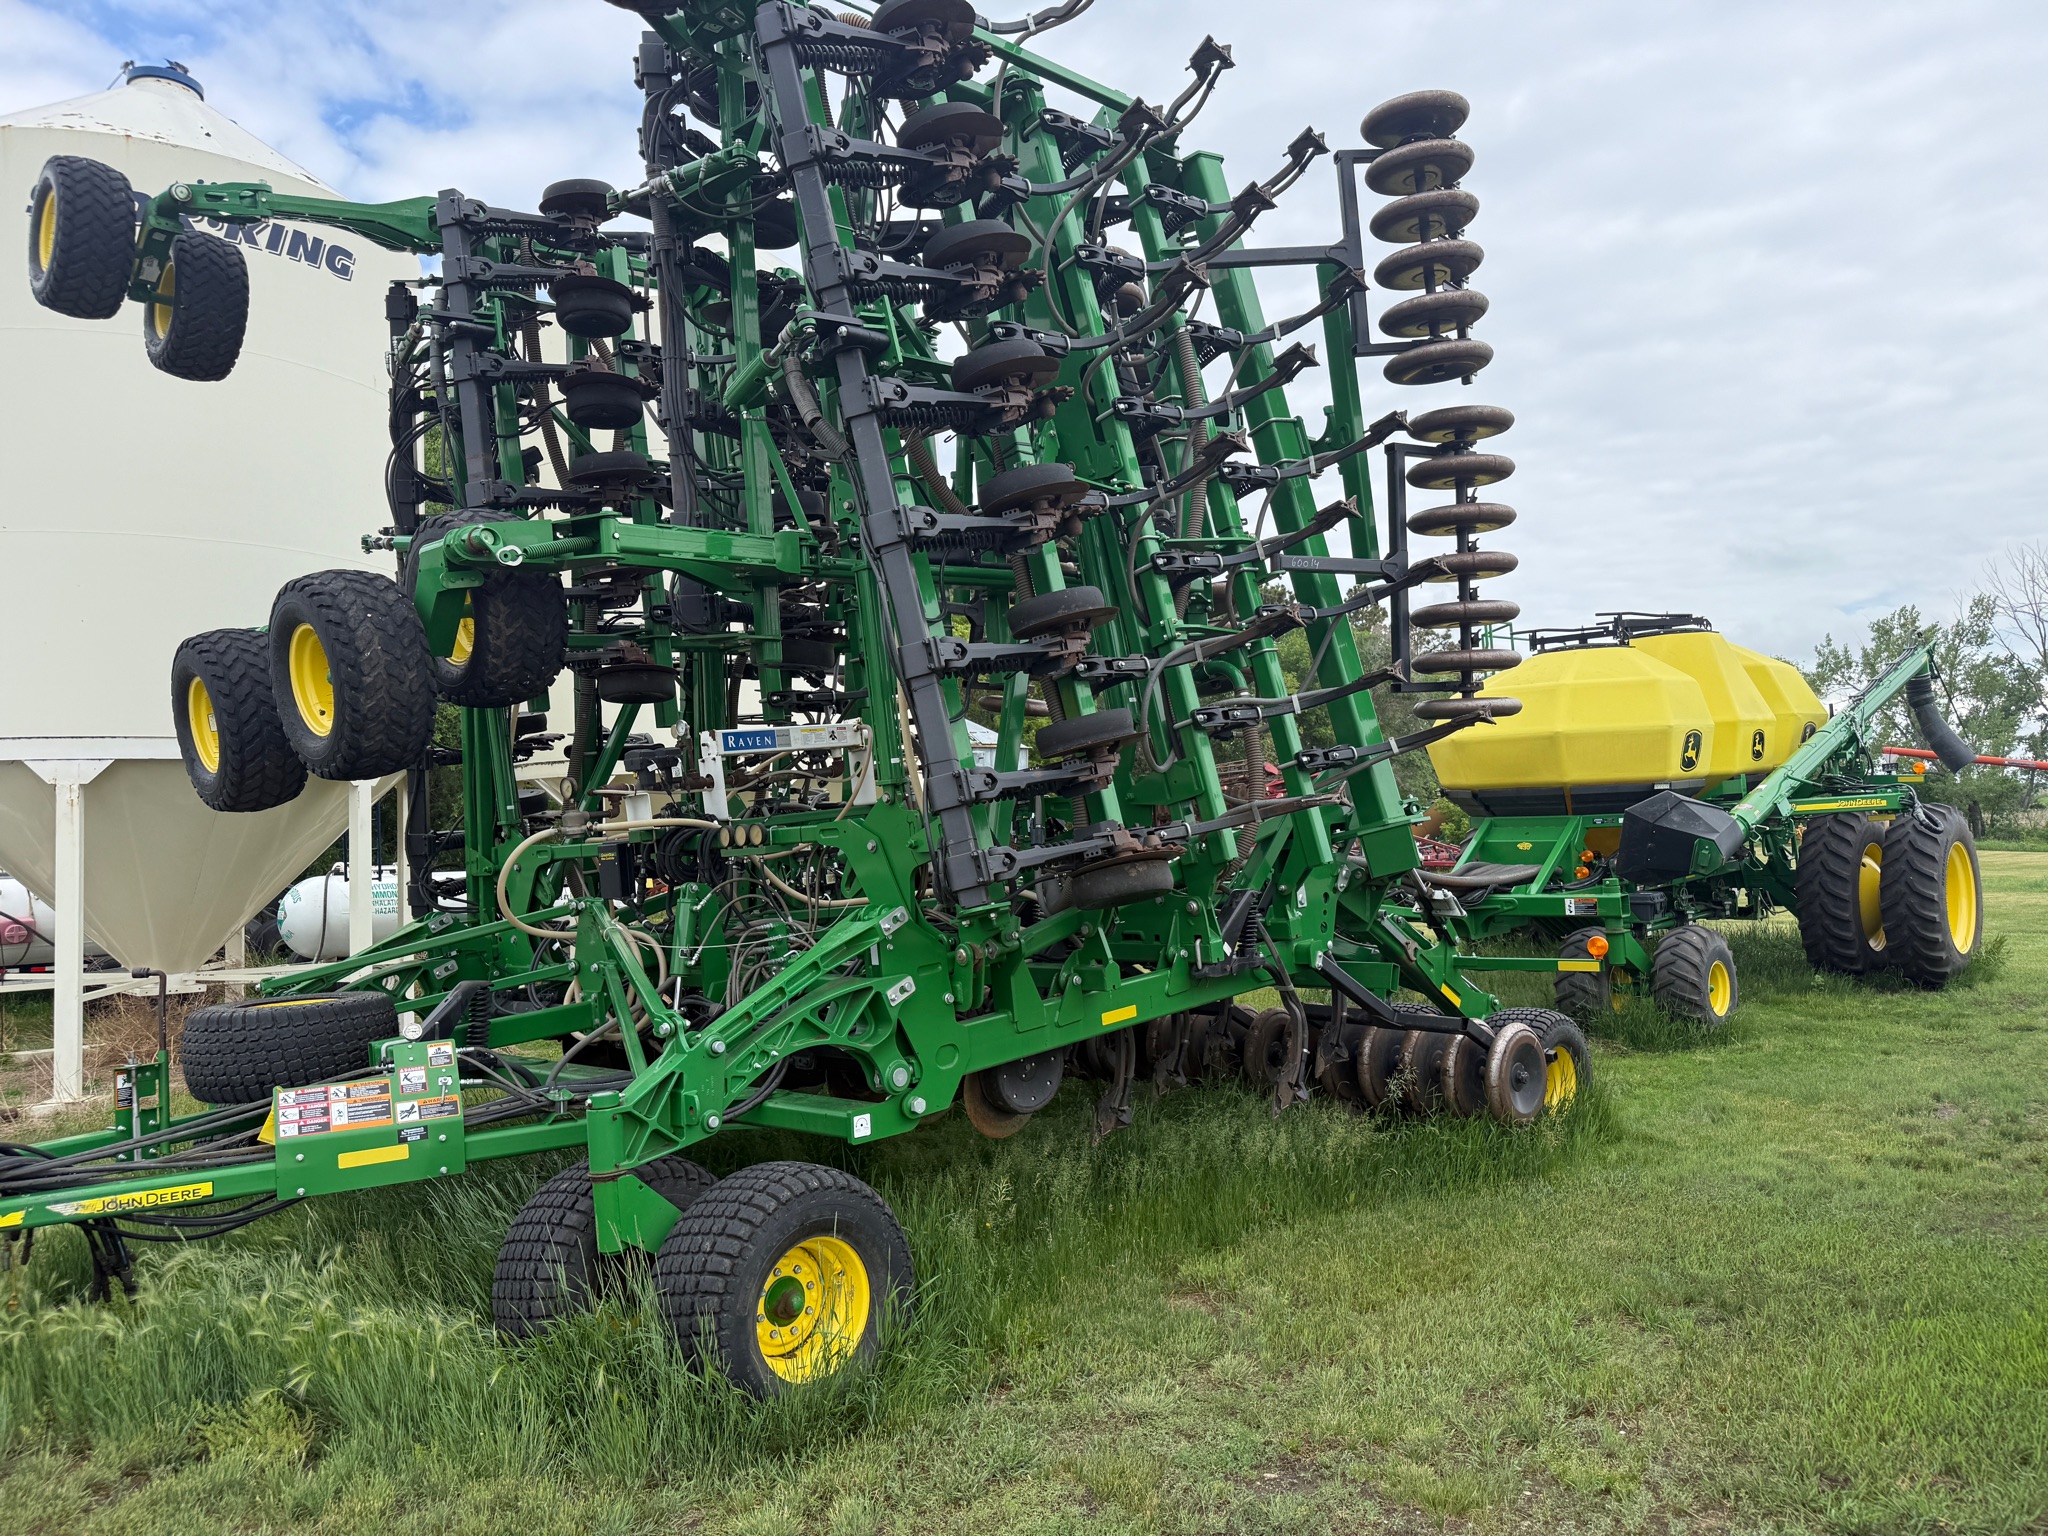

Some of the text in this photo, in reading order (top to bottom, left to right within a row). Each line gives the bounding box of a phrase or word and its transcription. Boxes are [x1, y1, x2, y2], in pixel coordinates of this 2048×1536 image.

[727, 735, 773, 748] RAVEN
[1836, 798, 1883, 808] JOHN DEERE
[371, 890, 398, 899] MMON
[96, 1188, 203, 1212] JOHN DEERE
